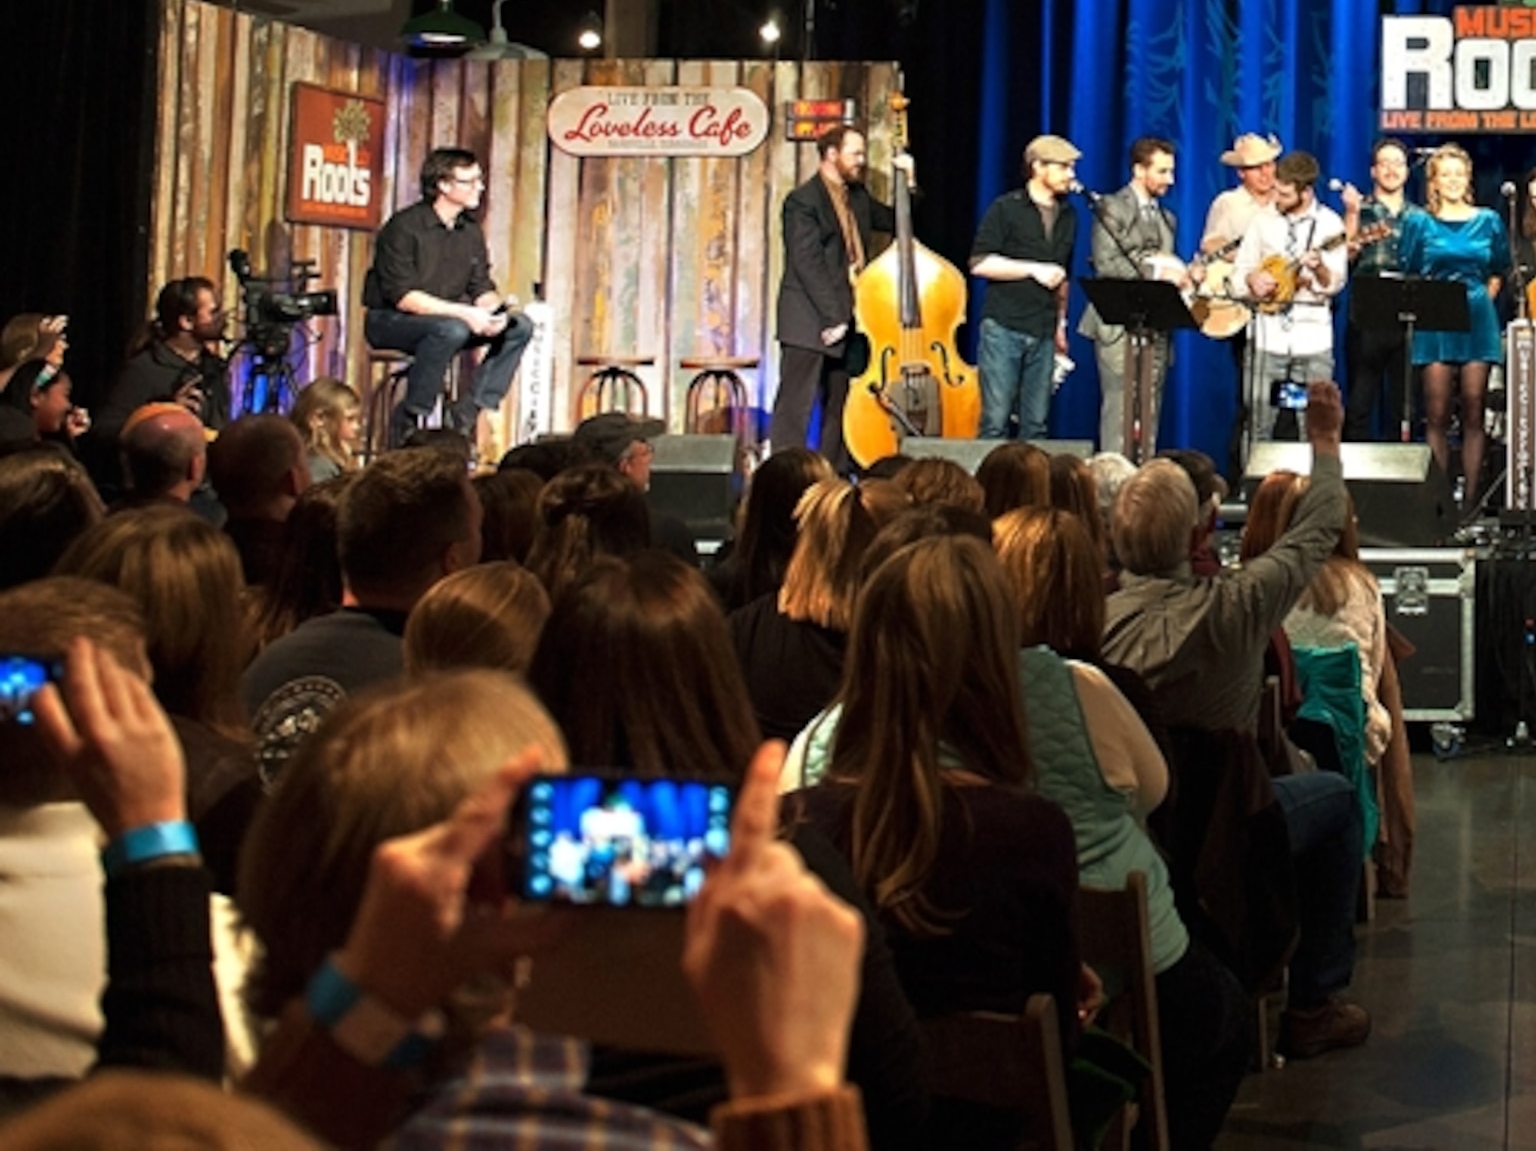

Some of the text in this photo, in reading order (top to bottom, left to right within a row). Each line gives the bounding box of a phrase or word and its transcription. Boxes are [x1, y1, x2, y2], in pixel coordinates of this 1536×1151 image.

[565, 103, 680, 142] Loveless
[689, 105, 753, 146] Cafe
[1382, 111, 1421, 129] LIVE
[1427, 111, 1478, 129] FROM
[1484, 111, 1516, 129] THE
[302, 144, 371, 207] Roots
